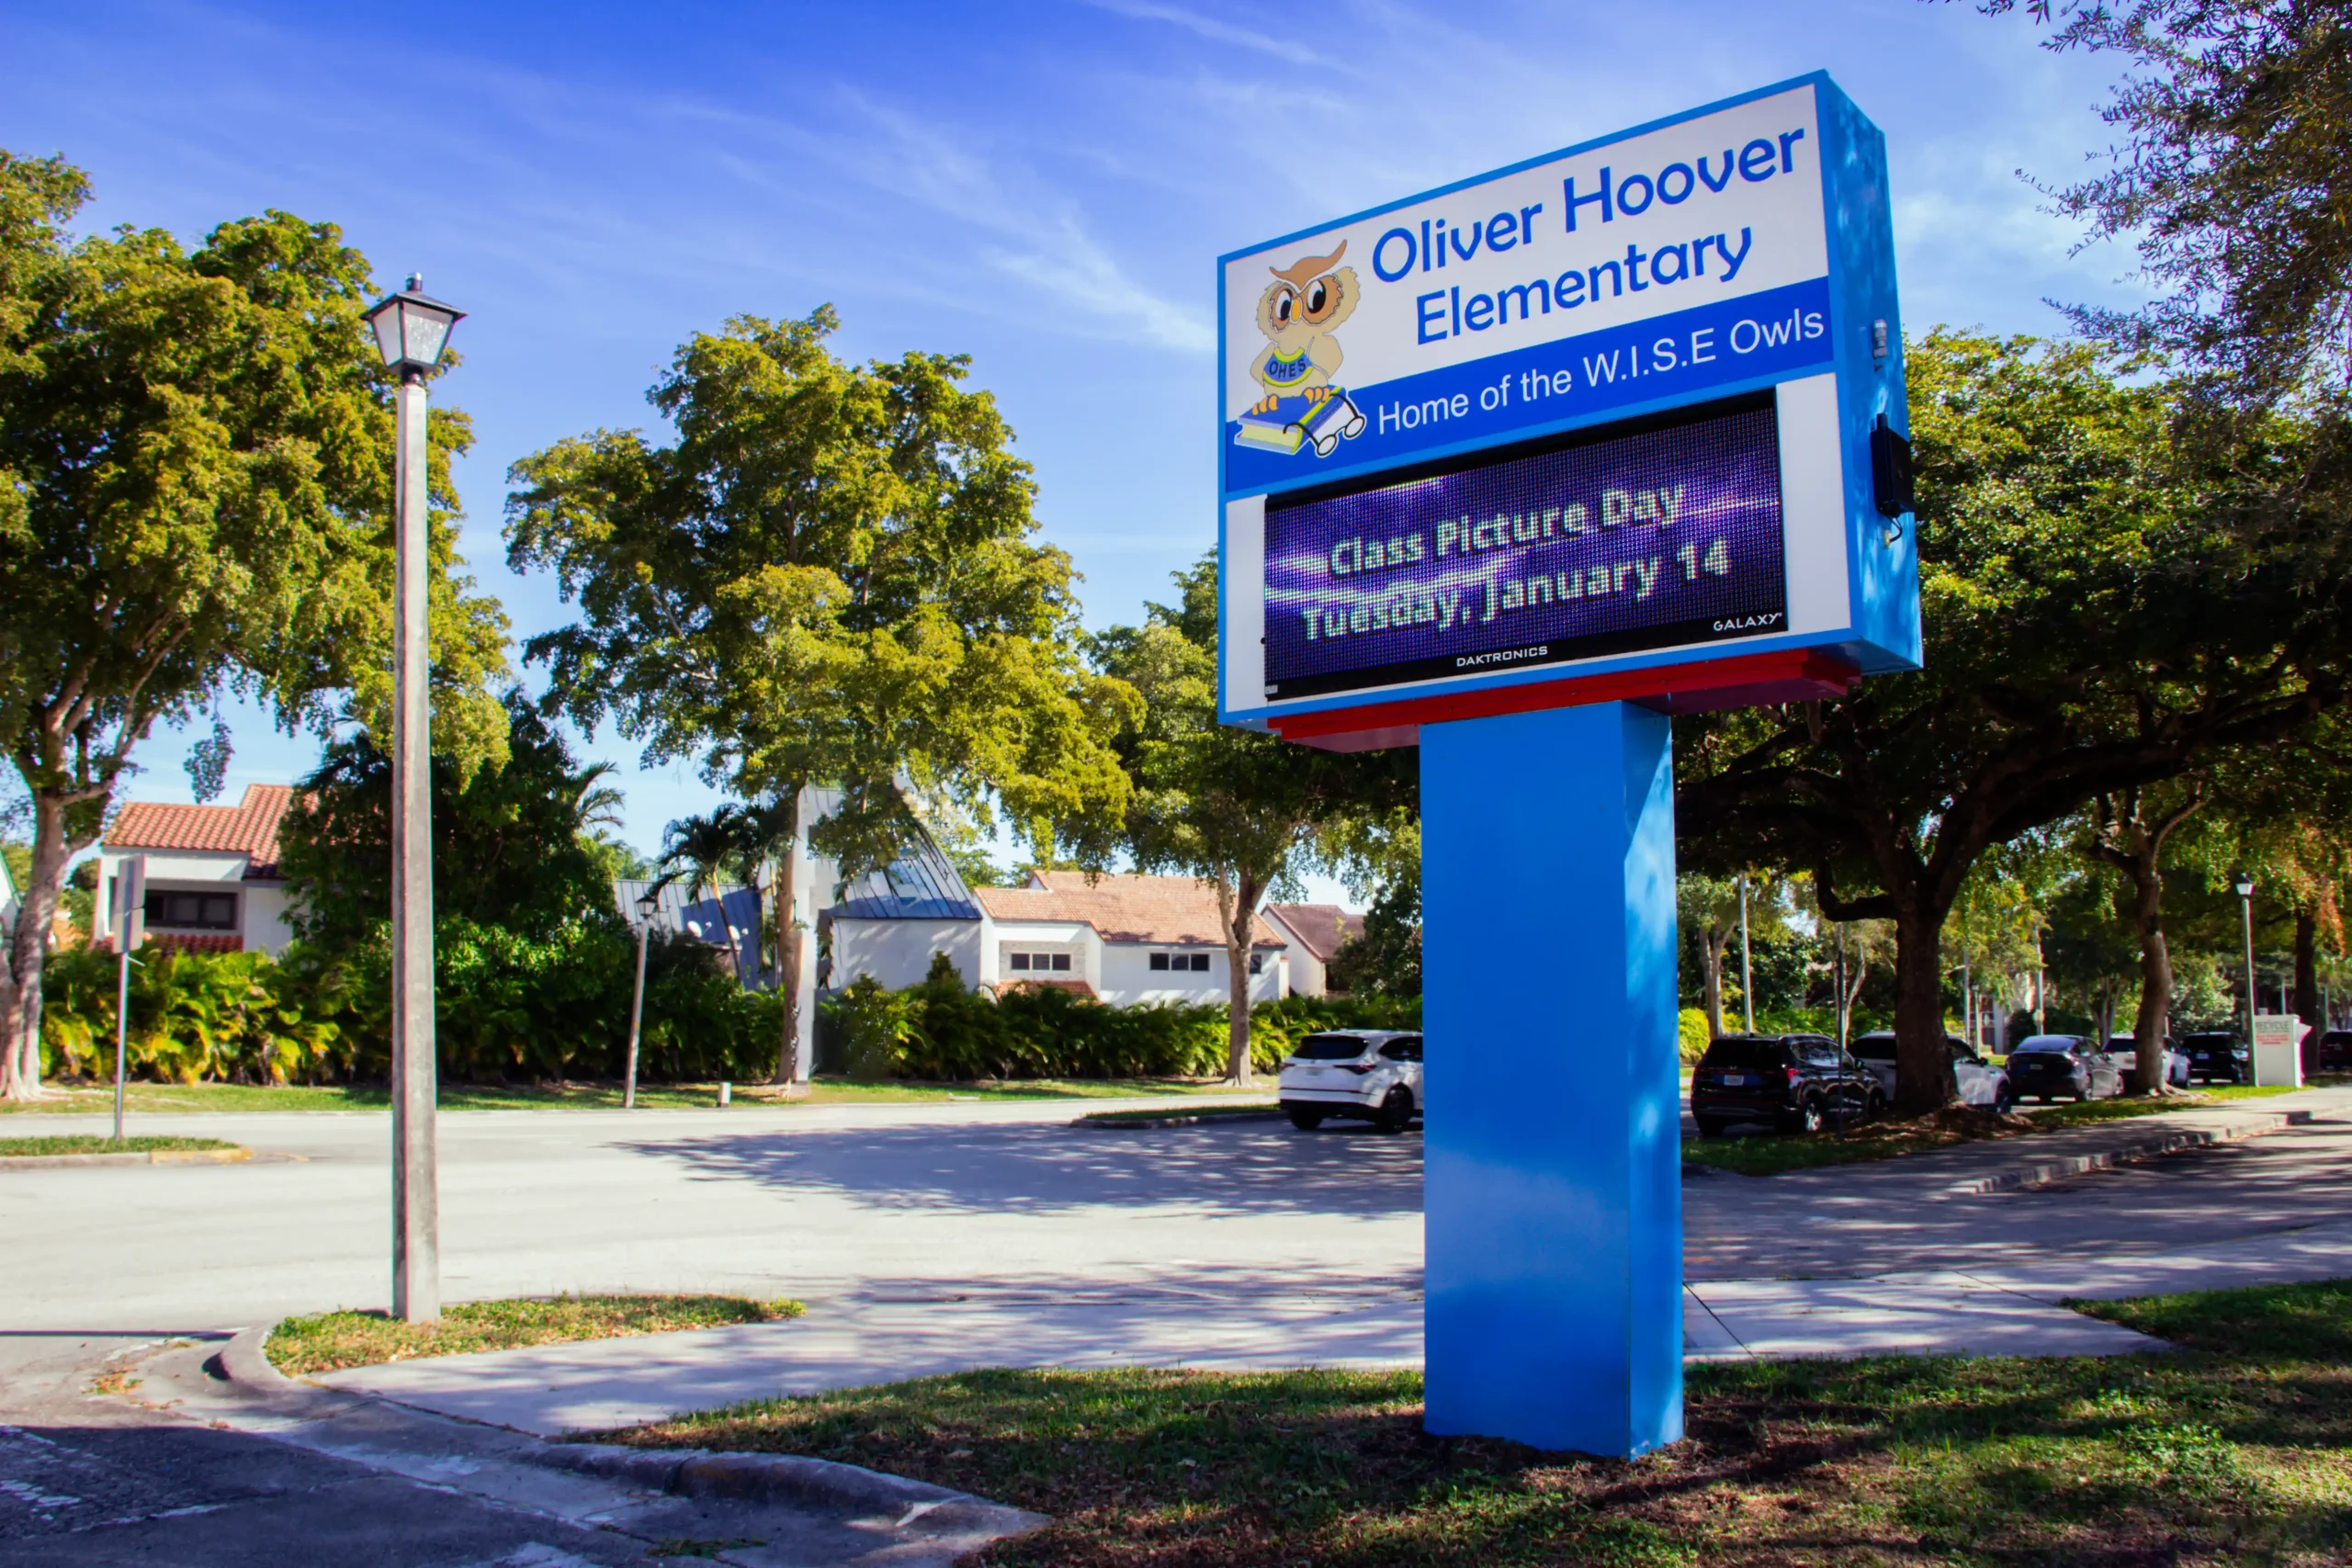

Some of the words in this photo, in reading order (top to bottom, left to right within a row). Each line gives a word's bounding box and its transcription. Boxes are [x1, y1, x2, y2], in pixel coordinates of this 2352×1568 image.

[1372, 202, 1543, 282] Oliver
[1563, 127, 1805, 232] Hoover
[1416, 226, 1753, 345] Elementary
[1269, 358, 1306, 378] OHES
[1379, 393, 1469, 434] Home
[1480, 374, 1511, 411] of
[1520, 368, 1572, 400] the
[1583, 327, 1716, 387] W.I.S.E
[1730, 310, 1825, 354] Owls
[1331, 532, 1423, 575] Class
[1436, 502, 1587, 557] Picture
[1601, 484, 1686, 529] Day
[1300, 581, 1471, 640] Tuesday,
[1480, 557, 1662, 625] January
[1677, 538, 1732, 581] 14
[1456, 646, 1548, 667] DAKTRONICS
